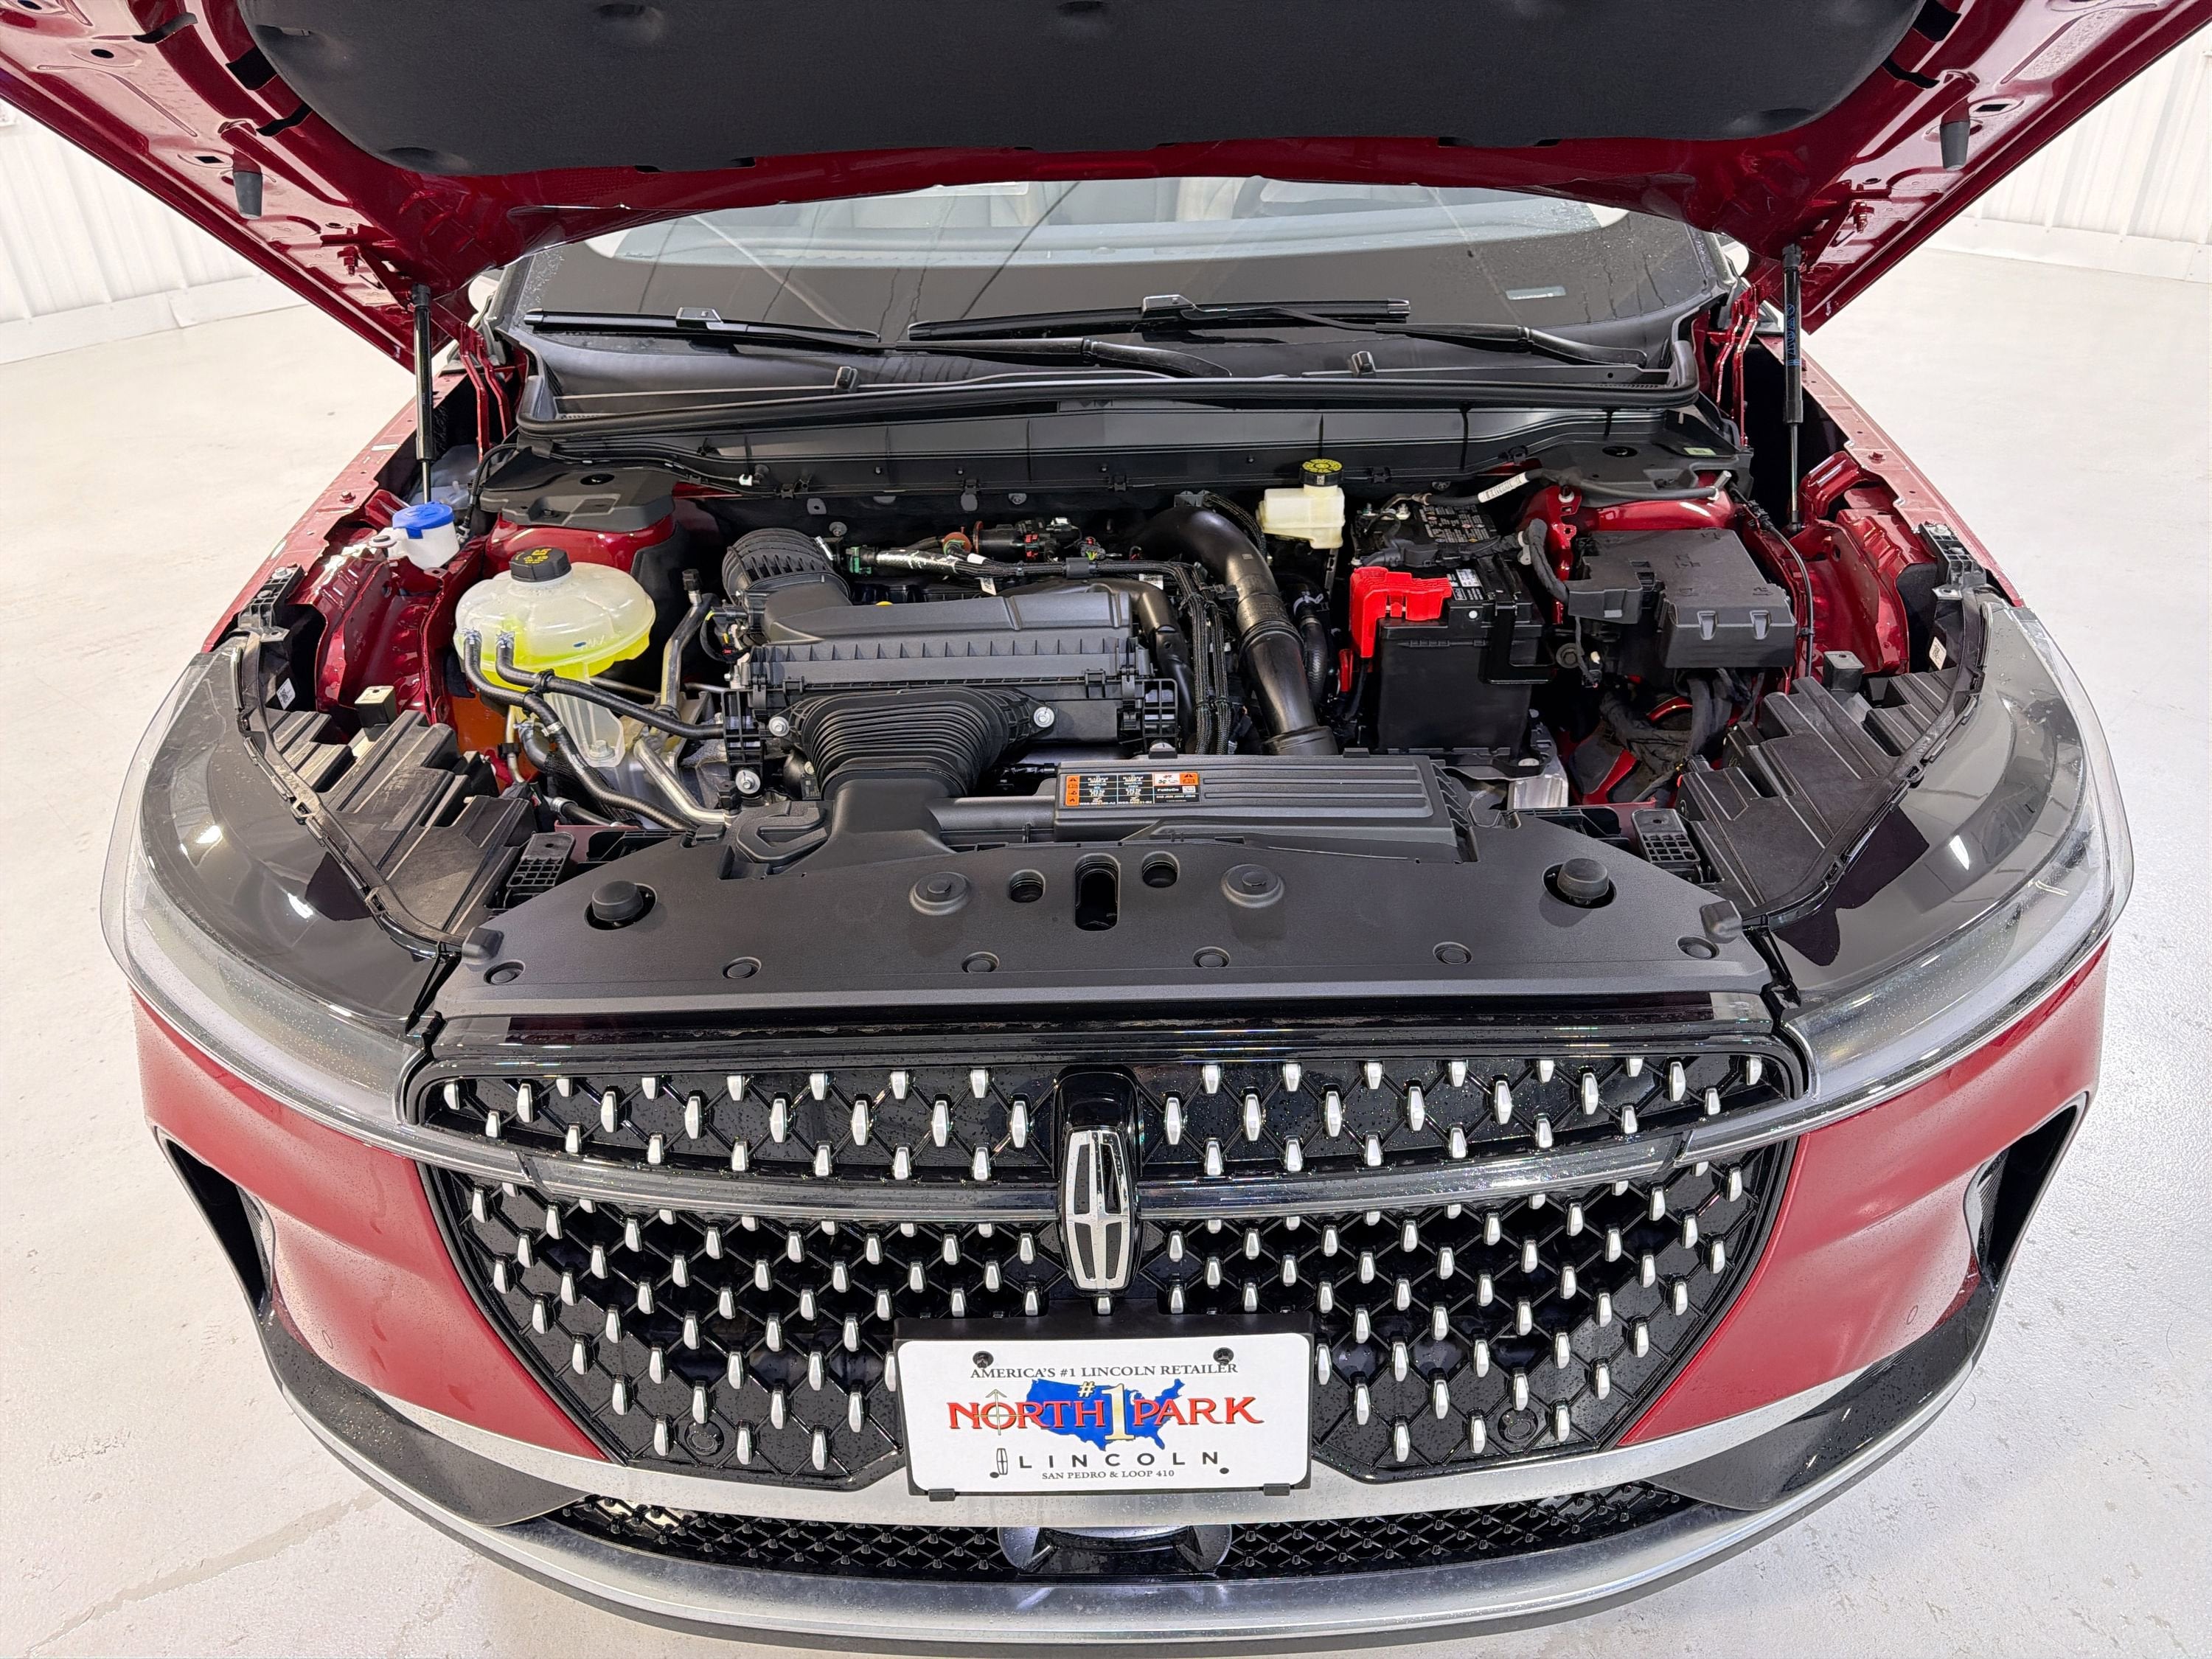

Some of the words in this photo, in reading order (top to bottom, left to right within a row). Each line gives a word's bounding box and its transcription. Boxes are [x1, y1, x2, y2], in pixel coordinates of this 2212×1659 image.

[970, 1367, 1056, 1379] AMERICA'S
[1060, 1368, 1077, 1377] #1
[1080, 1366, 1157, 1377] LINCOLN
[1160, 1363, 1239, 1375] RETAILER
[946, 1399, 1106, 1430] NORTH
[1132, 1396, 1265, 1426] PARK
[1019, 1451, 1218, 1469] LINCOLN
[1041, 1472, 1065, 1480] SAN
[1067, 1470, 1107, 1479] PEDRO
[1109, 1470, 1119, 1478] &
[1121, 1470, 1154, 1478] LOOP
[1155, 1469, 1175, 1478] 410
